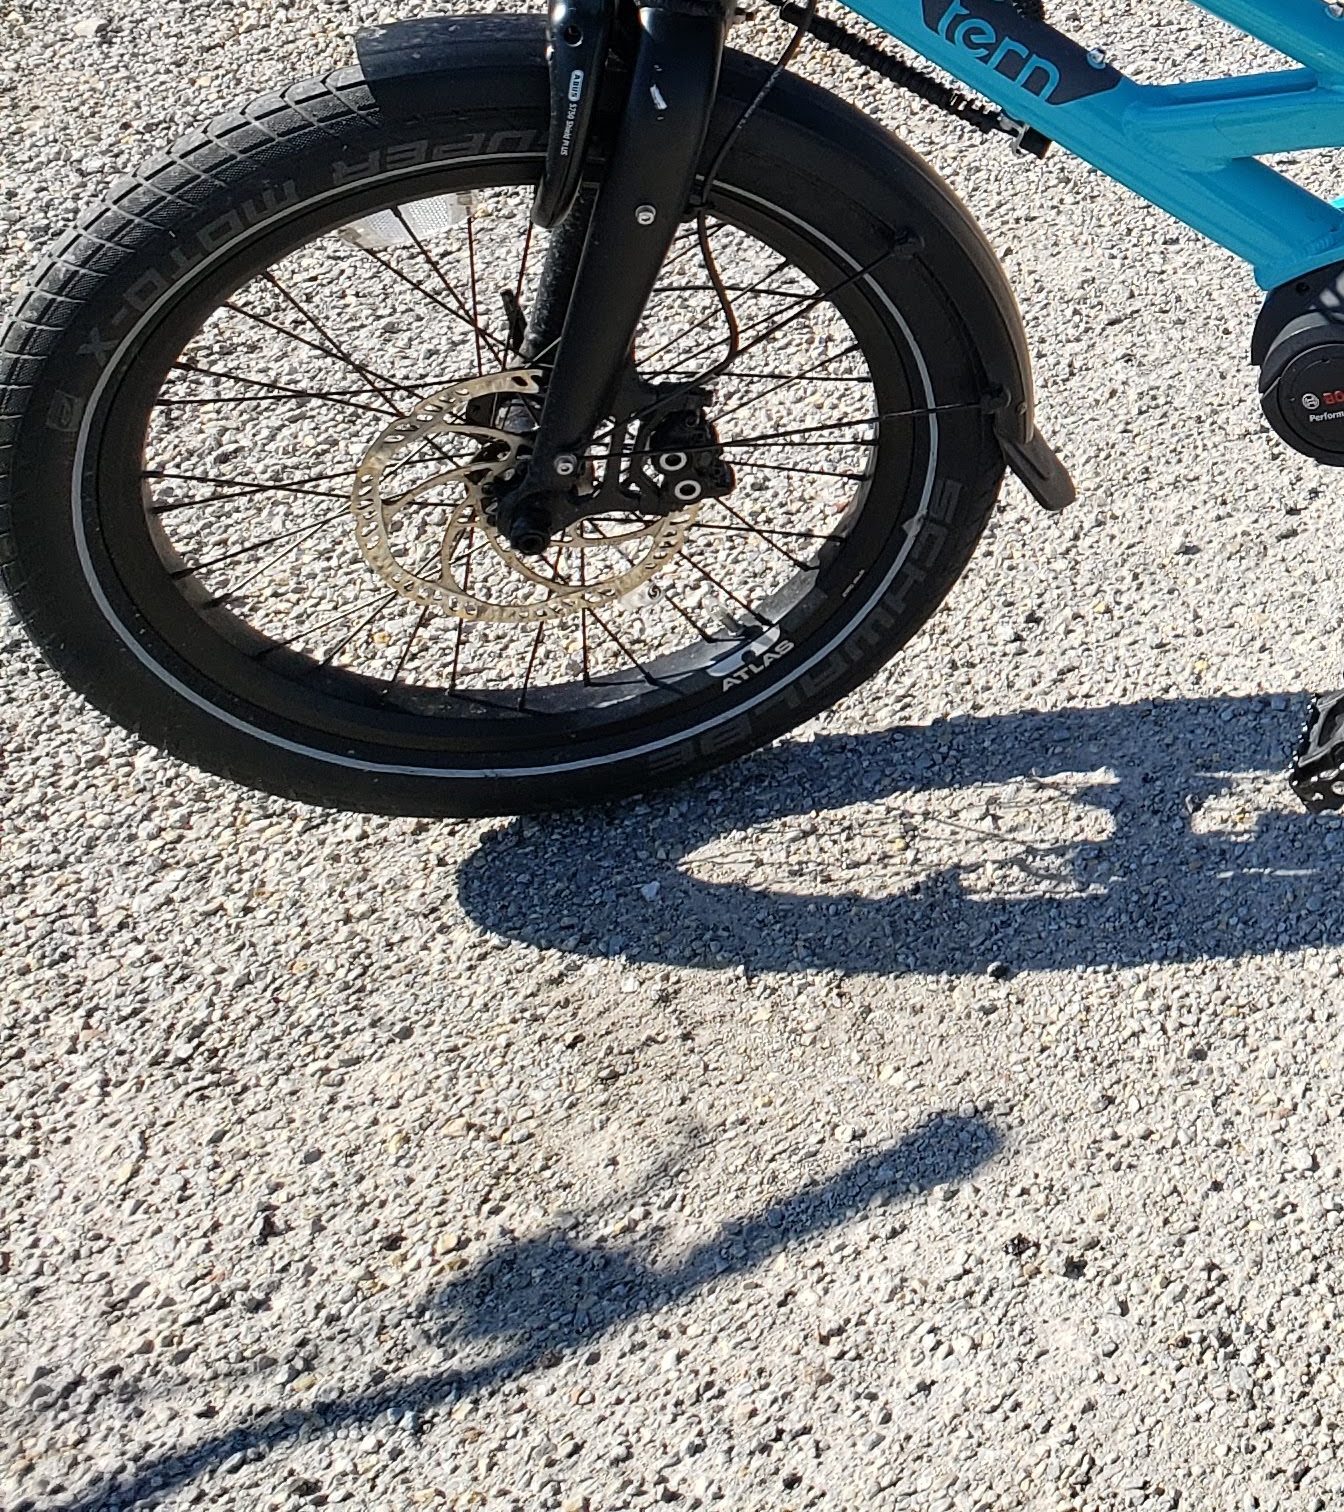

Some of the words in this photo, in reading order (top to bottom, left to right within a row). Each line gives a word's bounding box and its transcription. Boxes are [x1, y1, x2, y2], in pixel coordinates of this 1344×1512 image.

[571, 73, 581, 98] ABUS
[332, 129, 550, 185] UPER
[723, 639, 795, 692] ATLAS
